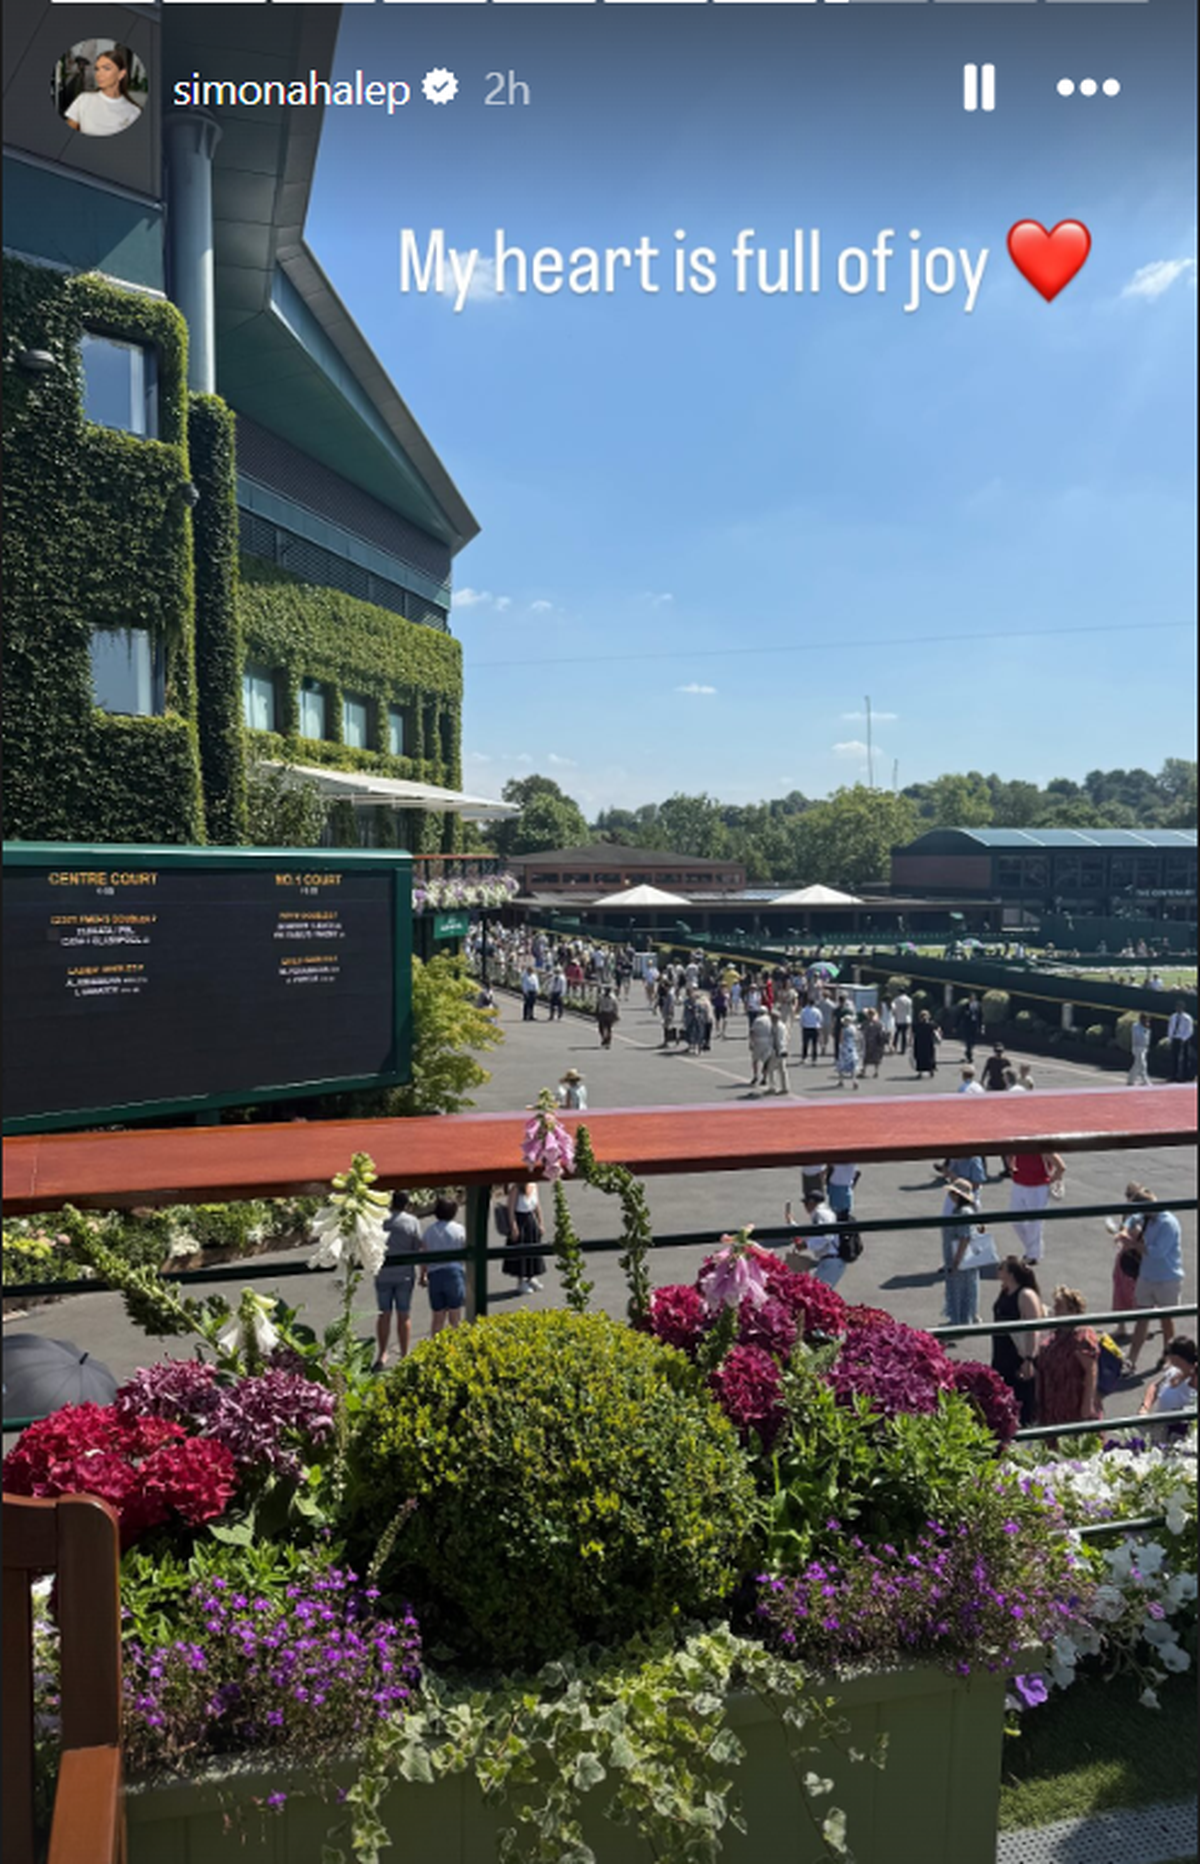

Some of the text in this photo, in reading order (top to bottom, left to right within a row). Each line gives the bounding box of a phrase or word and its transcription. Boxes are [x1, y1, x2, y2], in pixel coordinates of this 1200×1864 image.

[48, 871, 158, 886] CENTRE COURT
[303, 874, 342, 886] COURT
